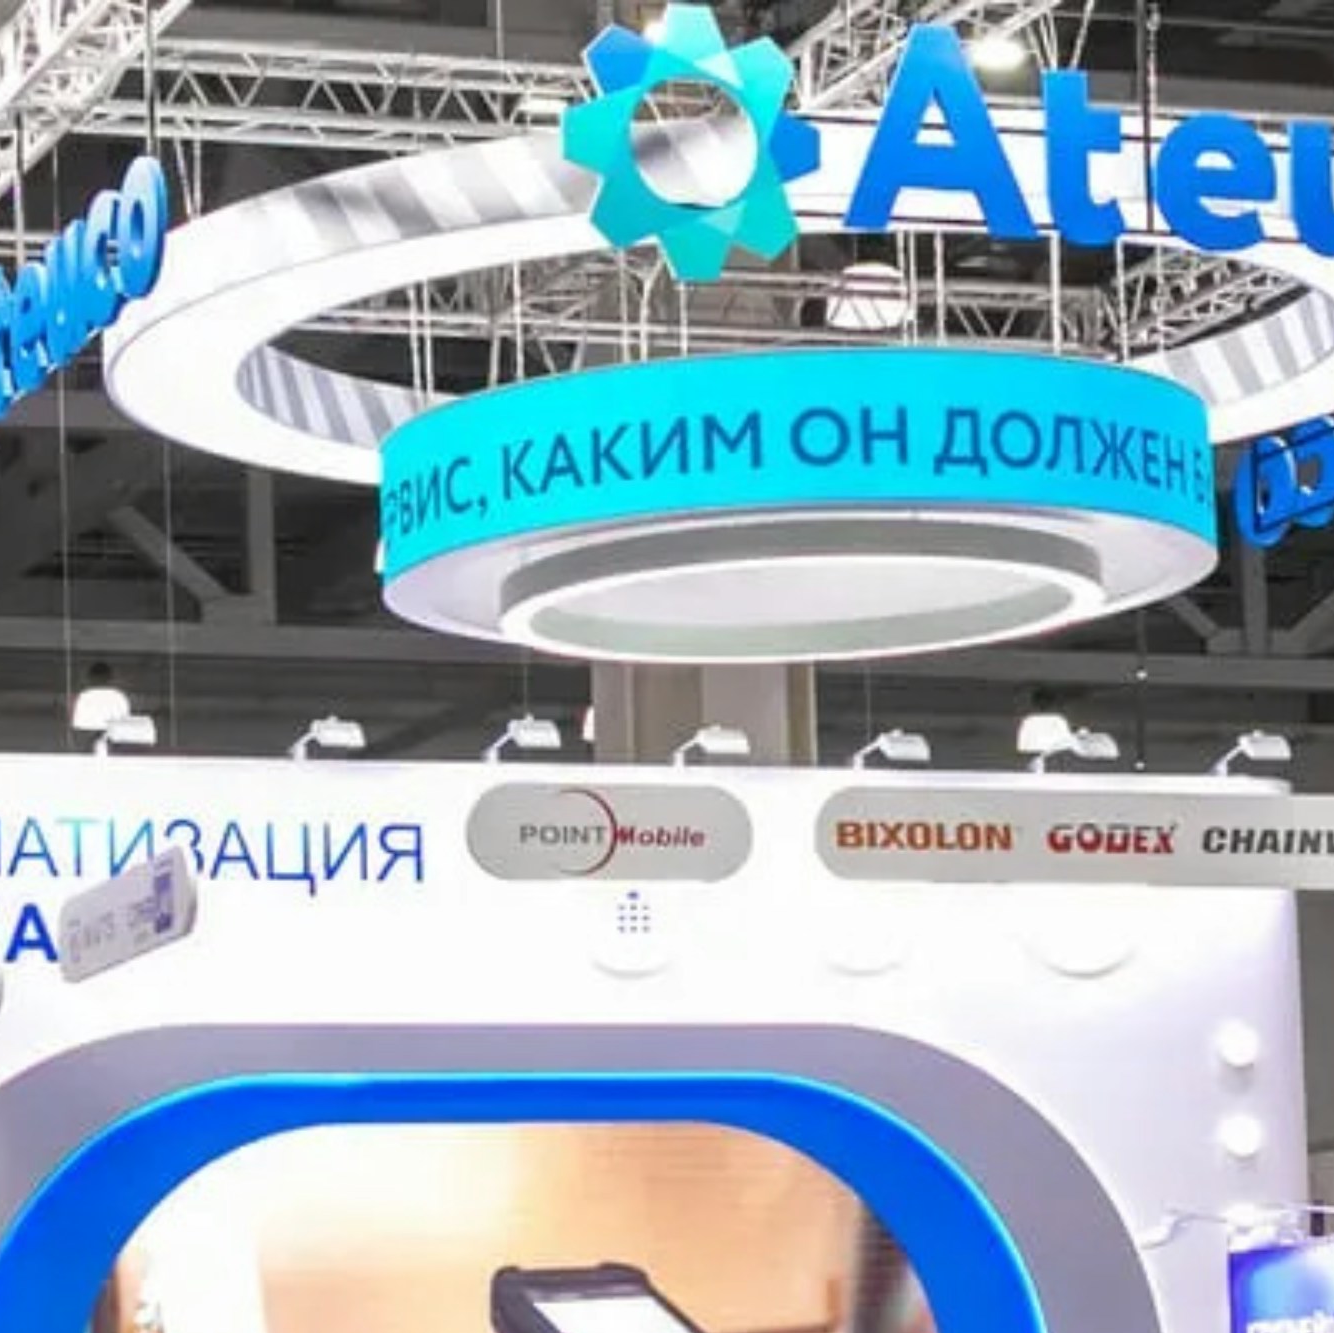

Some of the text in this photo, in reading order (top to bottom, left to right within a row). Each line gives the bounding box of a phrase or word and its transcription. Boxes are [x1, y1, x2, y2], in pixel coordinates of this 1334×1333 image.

[501, 410, 763, 501] КАКИМ
[790, 406, 908, 467] ОН
[933, 406, 1186, 495] ДОЛЖЕН
[519, 825, 705, 847] POINT Mobile
[837, 821, 1012, 850] BIXOLON
[1047, 822, 1176, 854] GODEX
